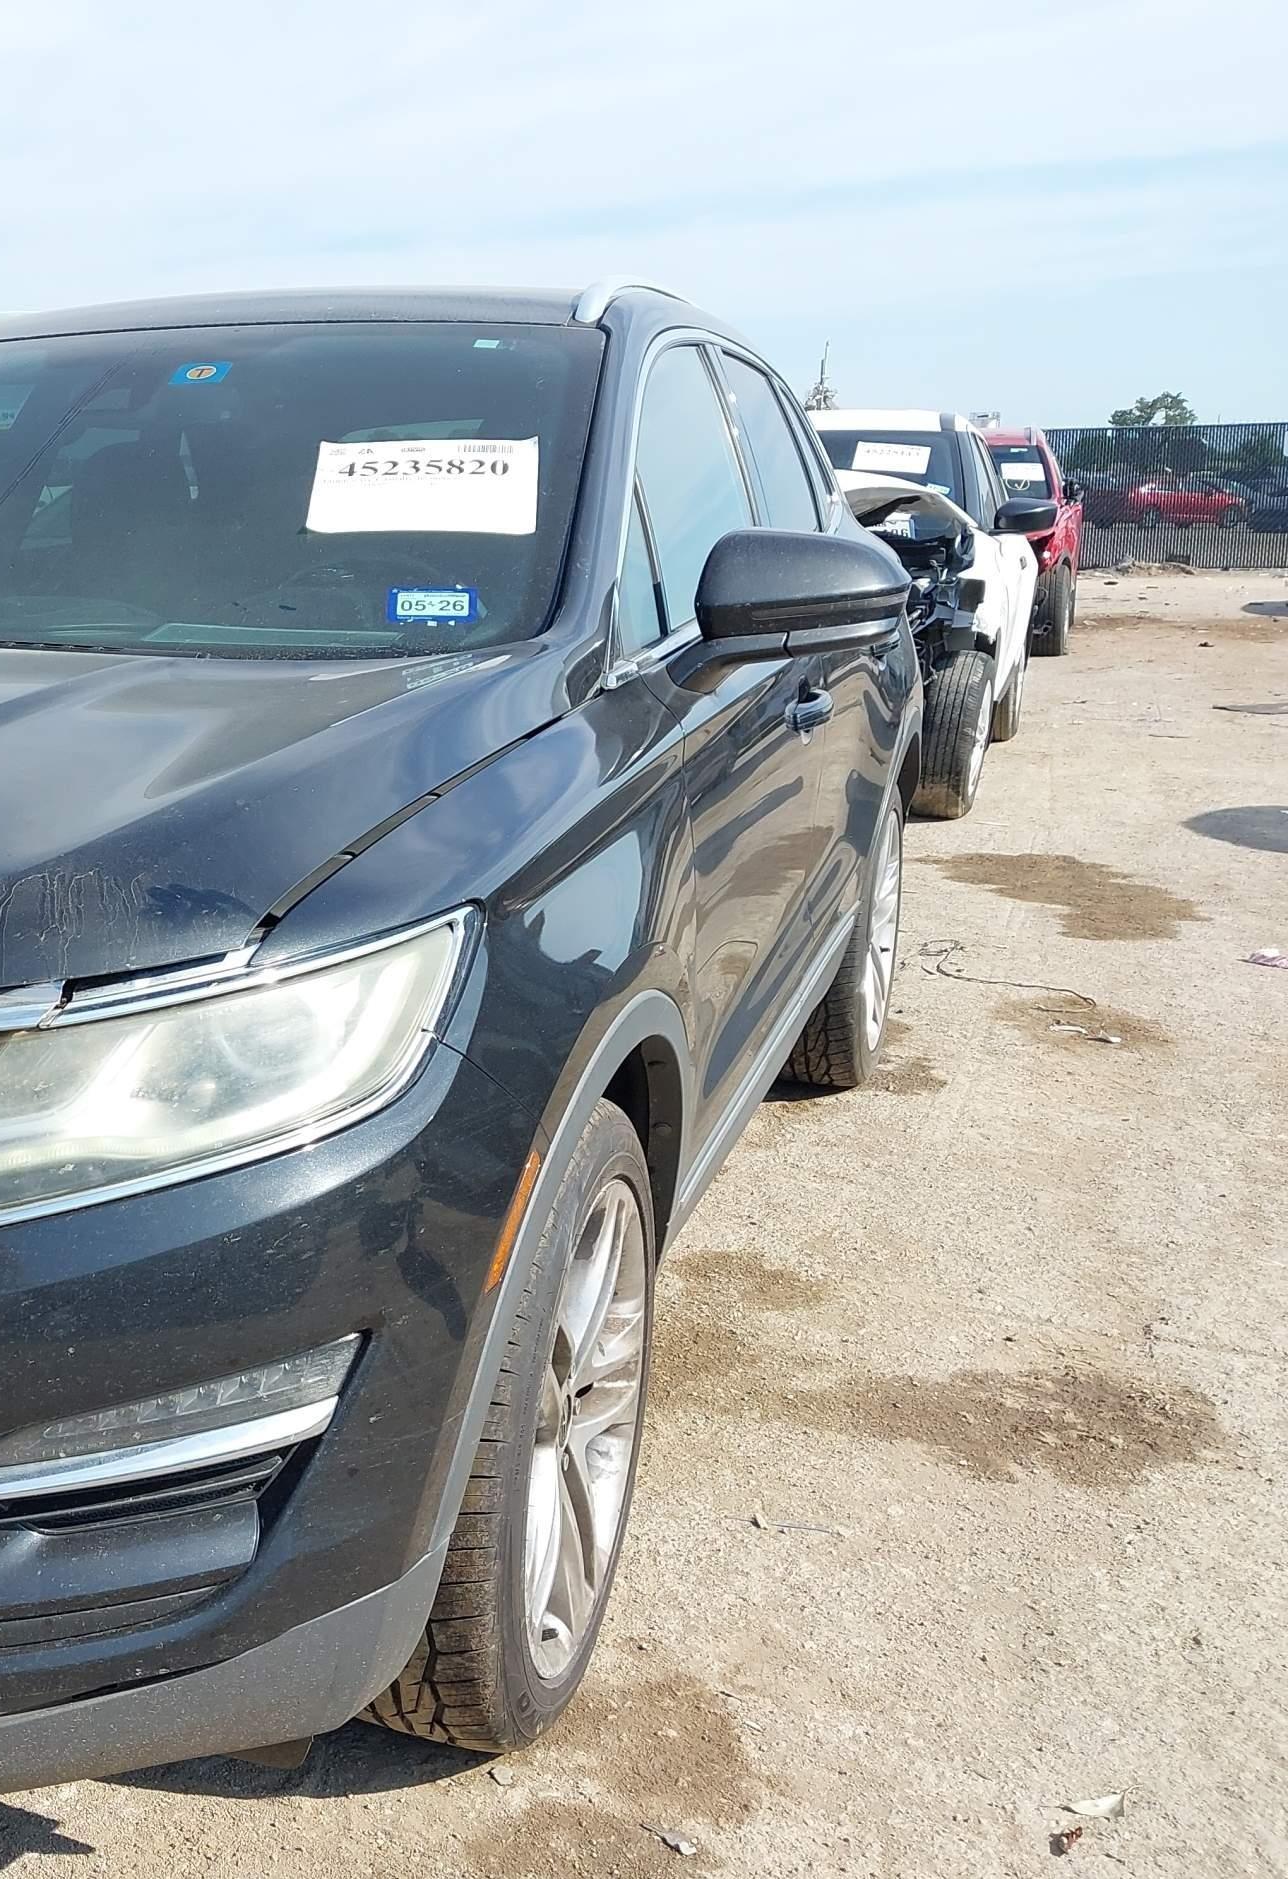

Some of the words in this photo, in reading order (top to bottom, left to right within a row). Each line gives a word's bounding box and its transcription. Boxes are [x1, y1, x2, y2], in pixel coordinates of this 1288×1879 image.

[338, 459, 510, 477] 45235820
[400, 599, 426, 612] 05
[437, 599, 465, 612] 26
